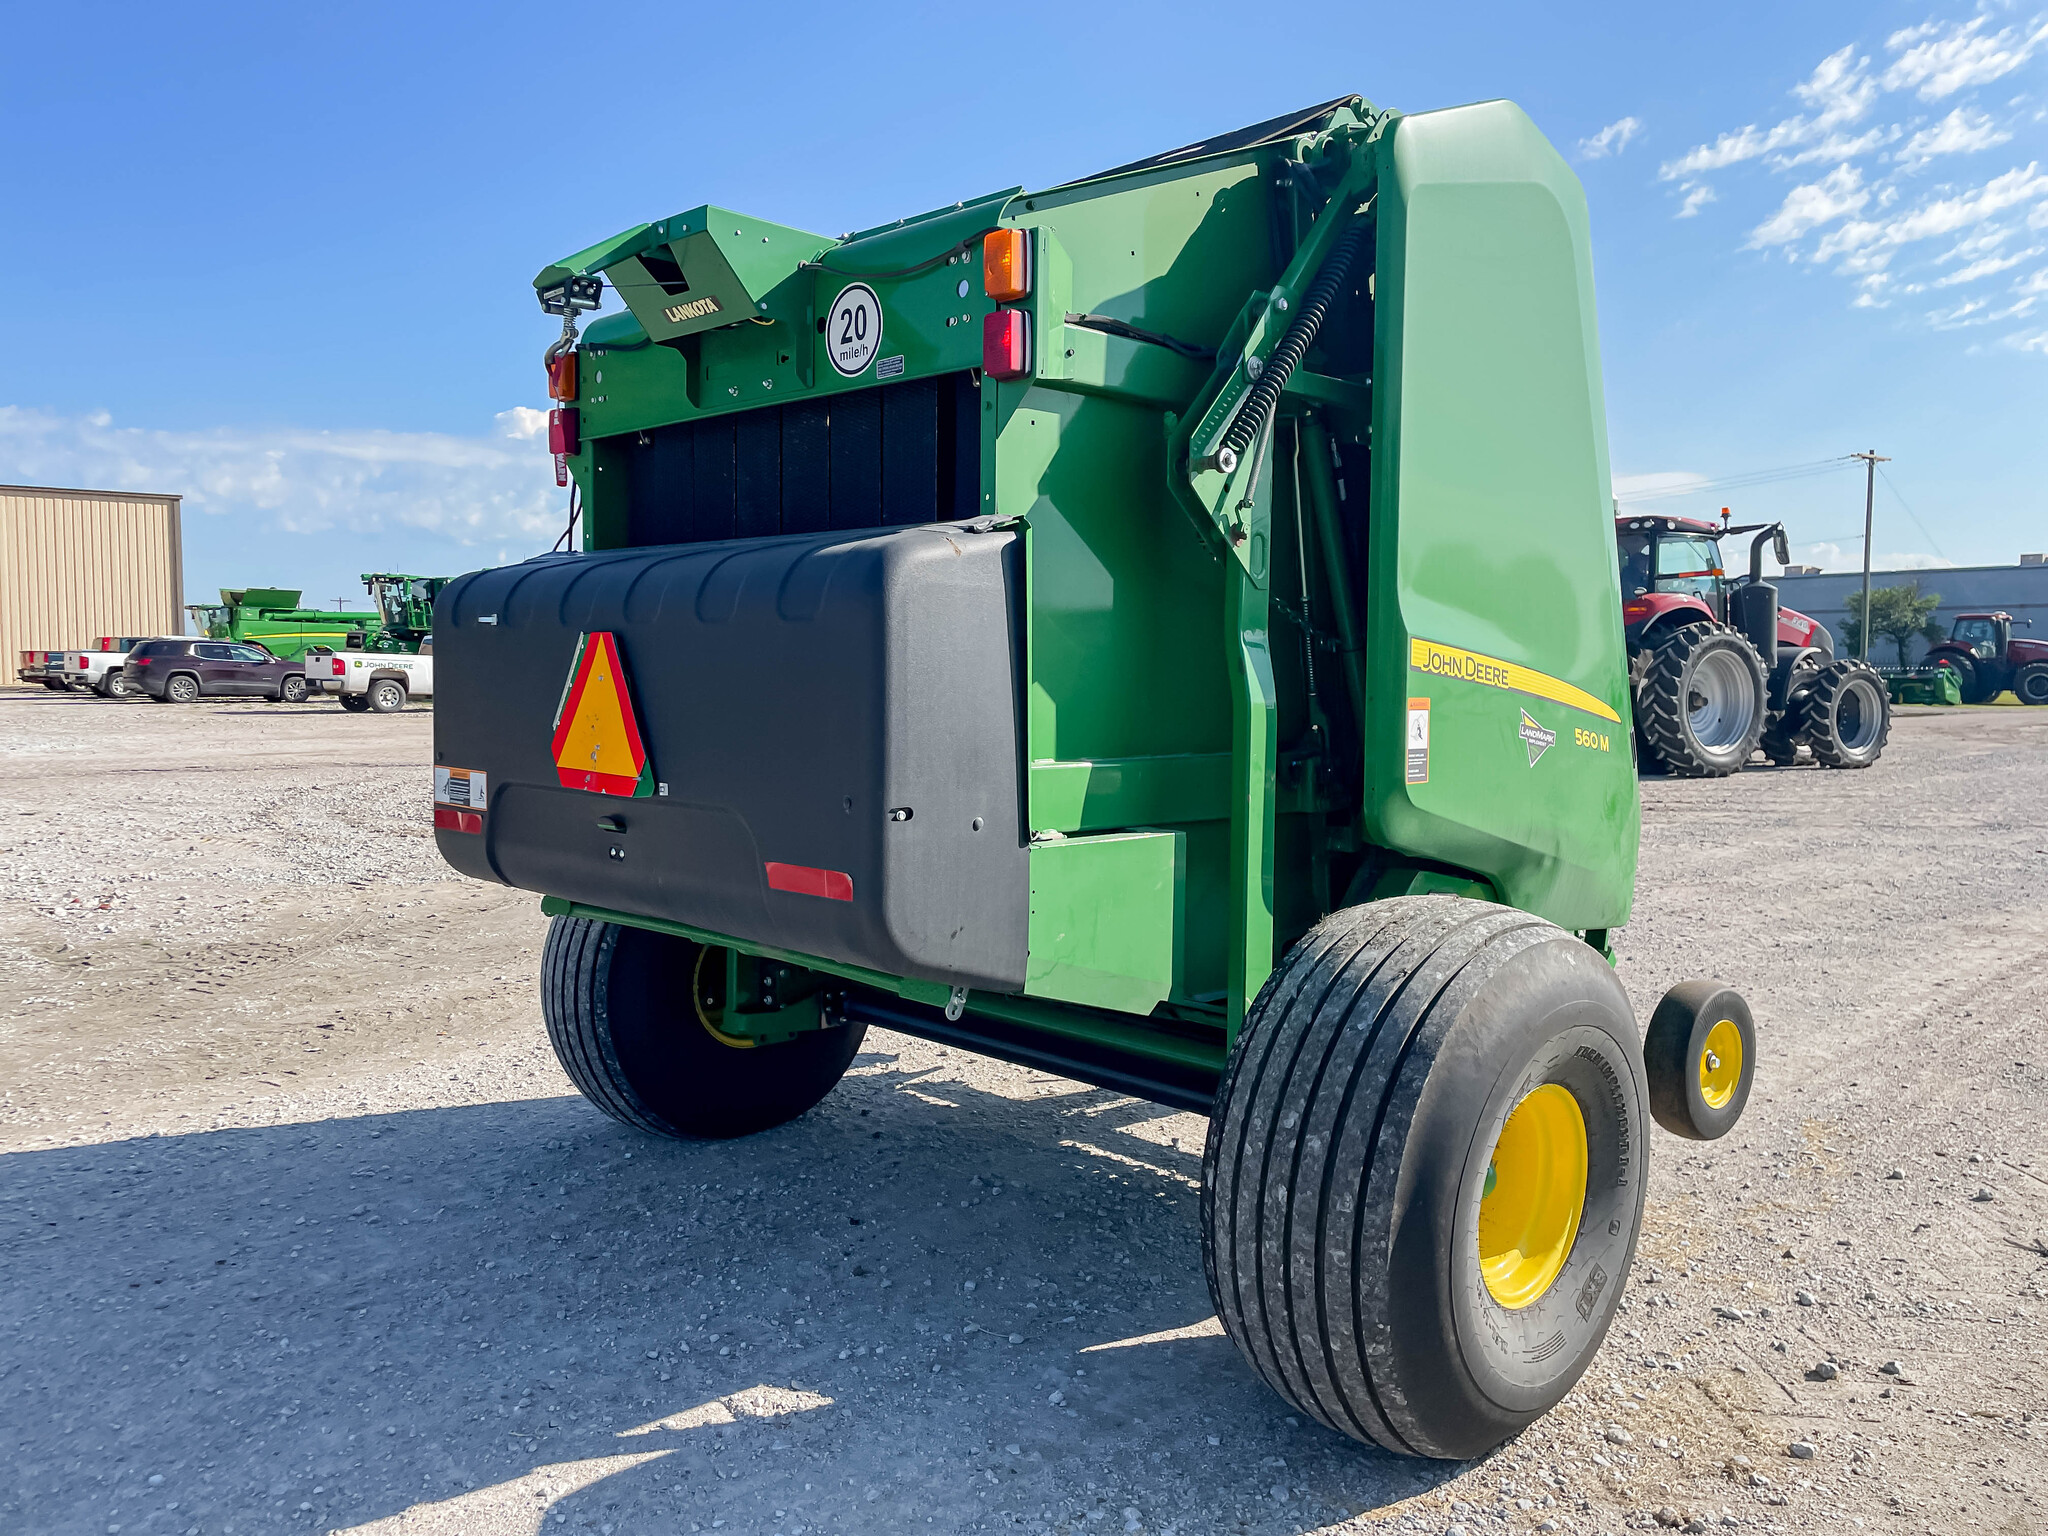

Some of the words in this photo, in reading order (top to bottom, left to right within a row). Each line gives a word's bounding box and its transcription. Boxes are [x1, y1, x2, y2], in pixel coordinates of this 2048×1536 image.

[665, 297, 719, 323] LANKOTA
[840, 304, 867, 345] 20
[840, 344, 869, 361] mile/h
[364, 661, 387, 669] JOHN
[1422, 648, 1462, 675] JOHN
[1465, 656, 1509, 686] DEERE
[1521, 726, 1554, 743] LANDMARK
[1574, 728, 1599, 750] 560
[1599, 734, 1610, 752] M
